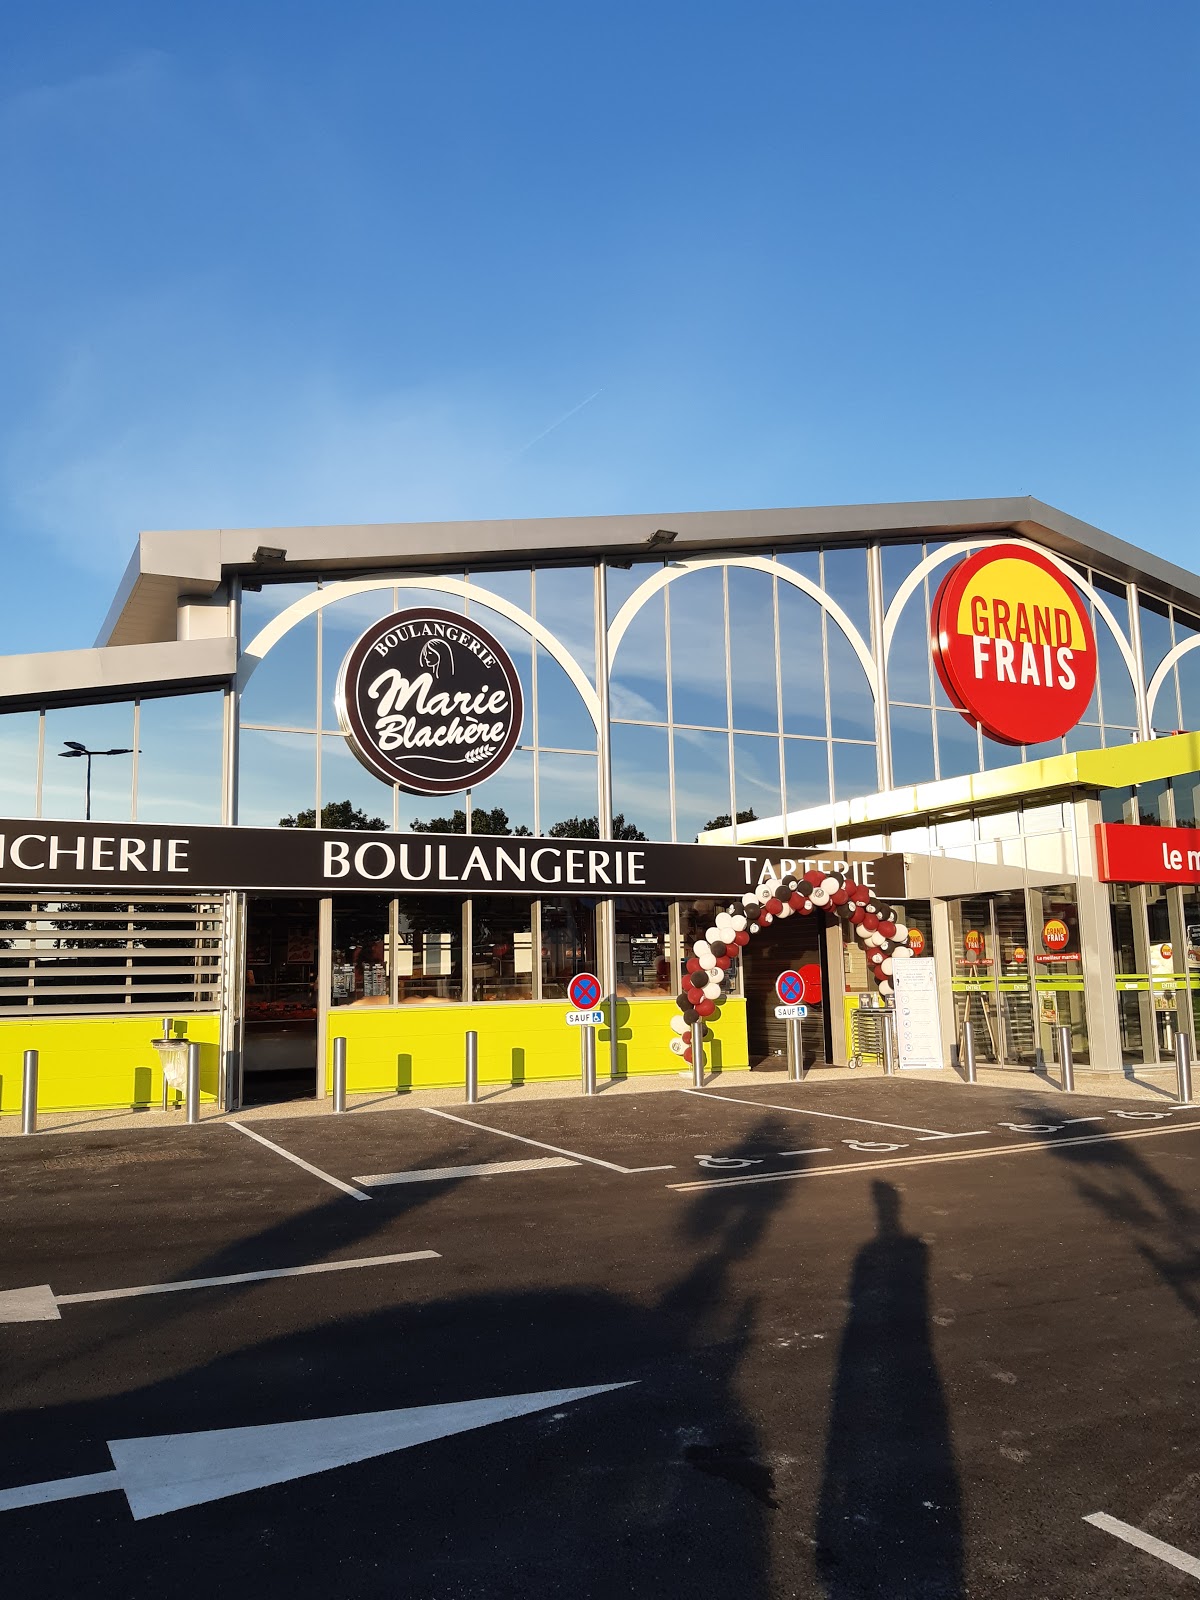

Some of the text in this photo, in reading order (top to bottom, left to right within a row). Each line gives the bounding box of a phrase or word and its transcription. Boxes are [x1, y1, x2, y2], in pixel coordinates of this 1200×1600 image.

[970, 595, 1073, 649] GRAND
[374, 623, 496, 669] BOULANGERIE
[972, 635, 1076, 690] FRAIS
[368, 668, 509, 717] Marie
[374, 714, 506, 751] Blachère
[323, 841, 646, 885] BOULANGERIE
[1162, 842, 1183, 870] le
[1047, 934, 1065, 942] FRAIS
[569, 1013, 591, 1023] SAUF
[778, 1008, 796, 1016] SAUF
